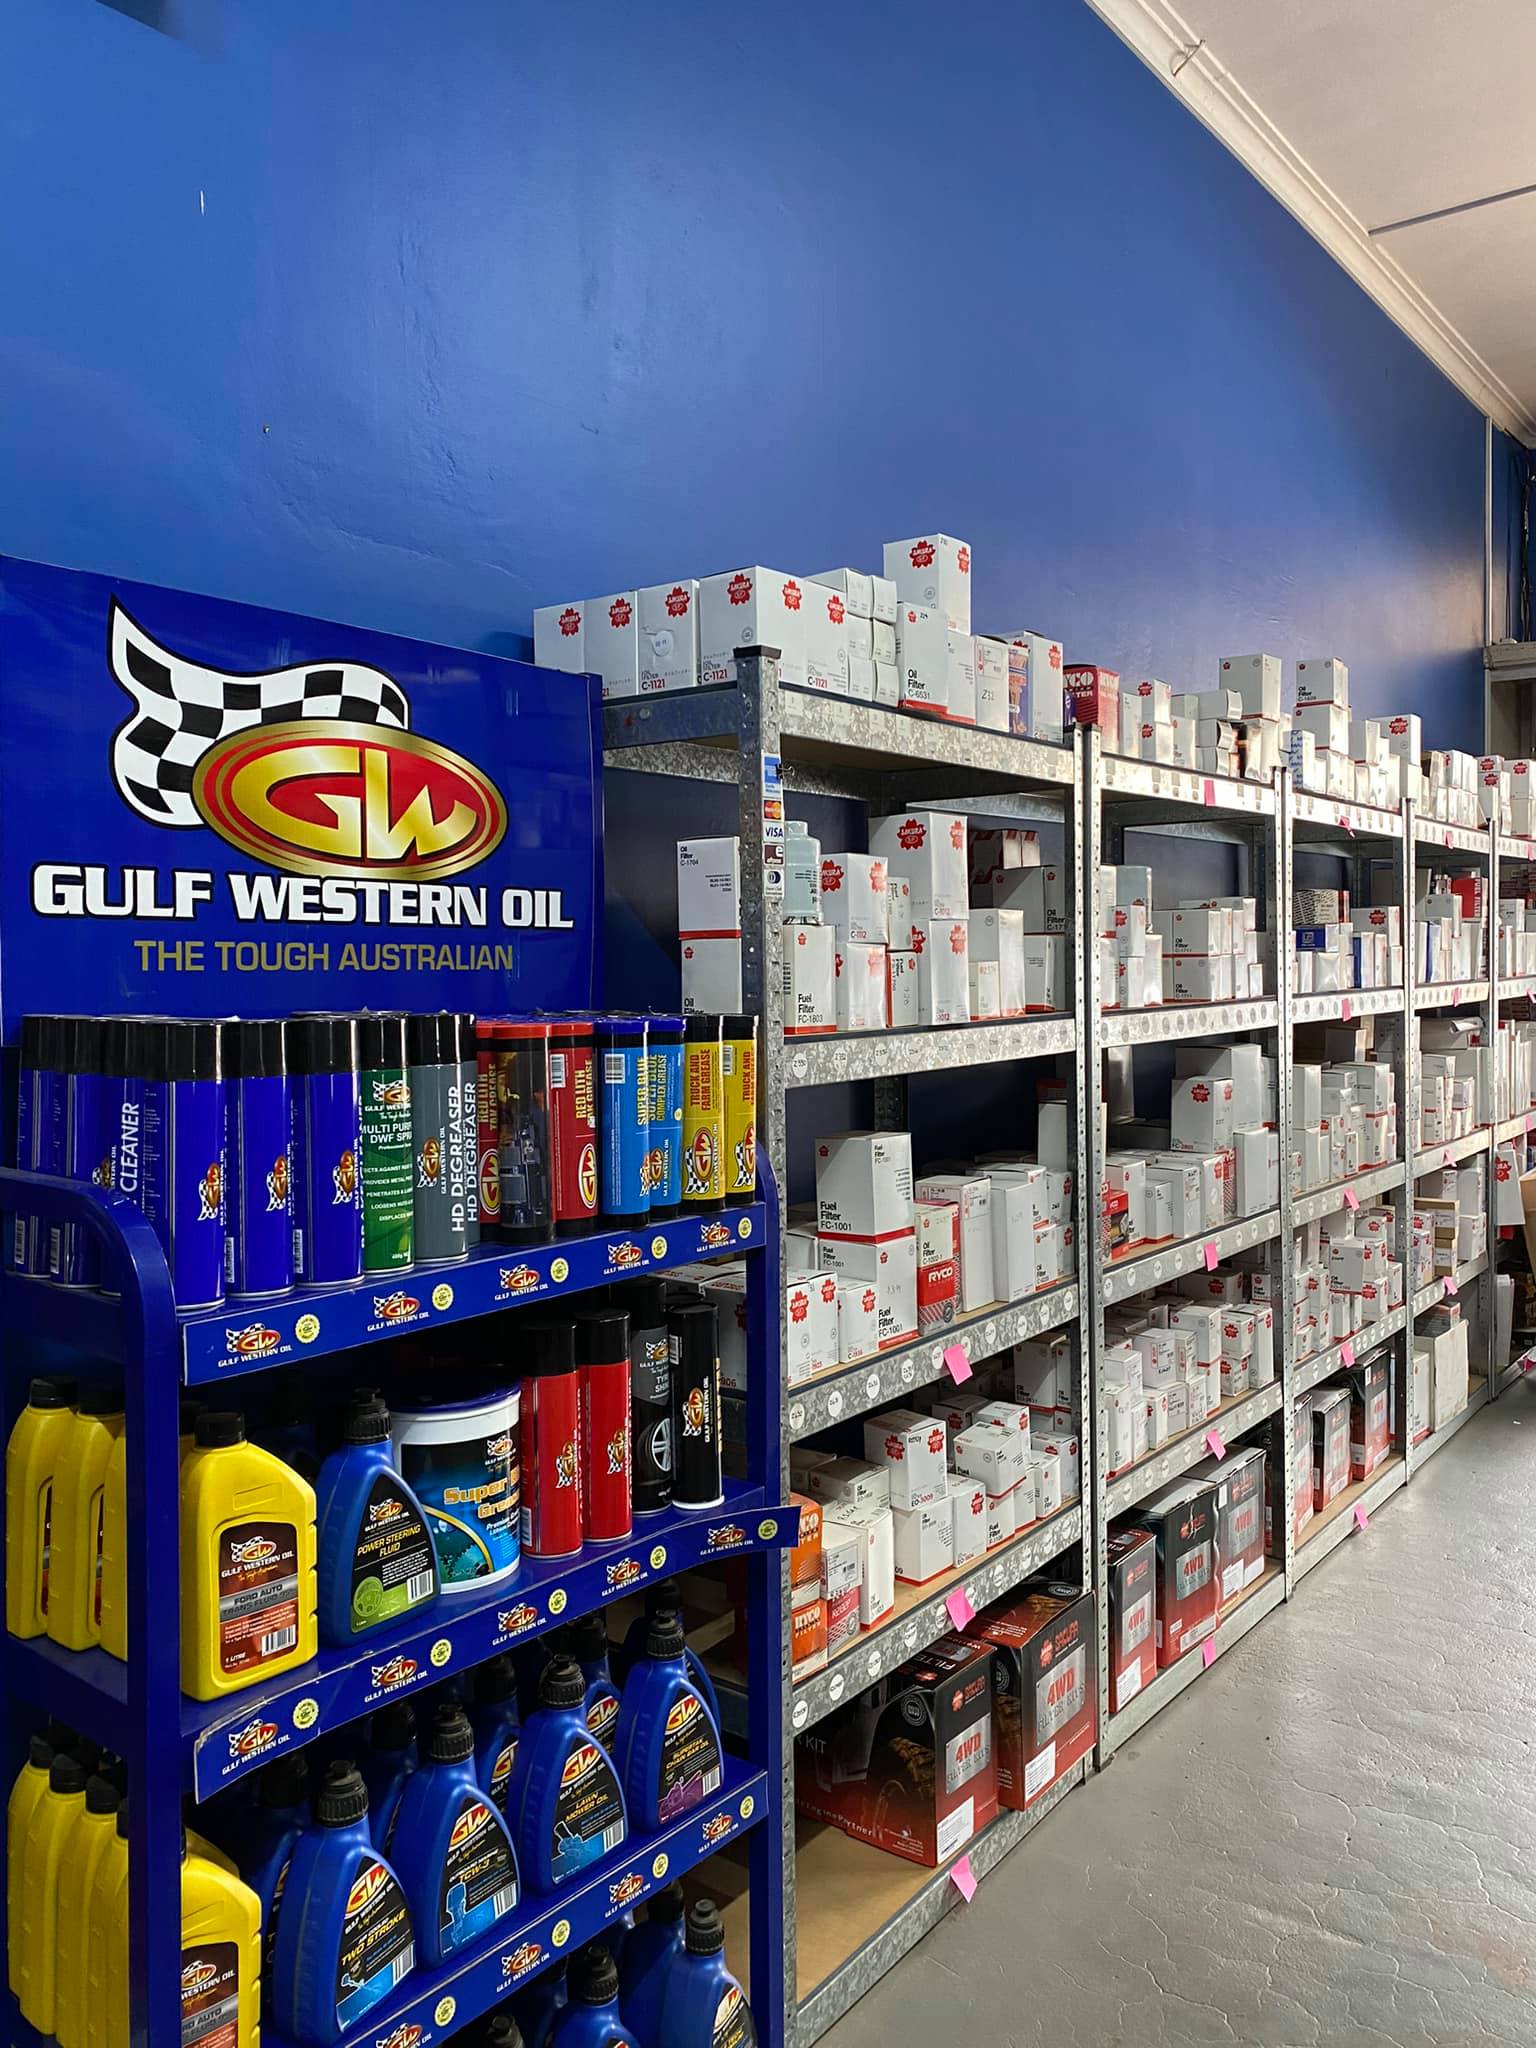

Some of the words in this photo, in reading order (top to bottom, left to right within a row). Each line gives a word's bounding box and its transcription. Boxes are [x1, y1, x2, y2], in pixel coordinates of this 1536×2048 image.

[703, 669, 728, 682] C-1121
[807, 677, 828, 689] C-1121
[908, 668, 918, 679] Oil
[641, 679, 666, 691] C-1121
[908, 679, 926, 690] Filter
[231, 745, 478, 861] GW
[765, 826, 783, 838] VISA
[33, 865, 213, 918] GULF
[228, 873, 488, 926] WESTERN
[501, 889, 575, 929] OIL
[134, 940, 205, 972] THE
[213, 940, 329, 972] TOUGH
[338, 943, 513, 971] AUSTRALIAN
[684, 998, 694, 1008] Oil
[798, 993, 813, 1003] Fuel
[798, 1003, 815, 1014] Filter
[657, 1053, 667, 1087] GREASE
[690, 1054, 700, 1074] AND
[701, 1048, 711, 1083] GREASE
[743, 1051, 751, 1070] AND
[574, 1069, 586, 1094] LITH
[690, 1076, 700, 1107] TRUCK
[743, 1075, 751, 1102] TRUCK
[575, 1096, 587, 1119] RED
[701, 1084, 711, 1111] FARM
[448, 1086, 464, 1197] DEGREASER
[465, 1082, 478, 1189] DEGREASER
[120, 1102, 139, 1192] CLEANER
[467, 1195, 478, 1222] HD
[820, 1201, 837, 1211] Fuel
[820, 1211, 841, 1222] Filter
[451, 1203, 465, 1232] HD
[820, 1221, 852, 1231] FC-1001
[823, 1246, 834, 1254] Fuel
[923, 1242, 931, 1250] Oil
[923, 1248, 936, 1257] Filter
[823, 1253, 836, 1261] Filter
[823, 1259, 845, 1268] FC-1001
[510, 1270, 537, 1288] GW
[928, 1267, 953, 1283] RYCO
[494, 1292, 510, 1301] GULF
[510, 1286, 539, 1299] WESTERN
[538, 1283, 549, 1291] OIL
[386, 1299, 417, 1316] GW
[878, 1308, 891, 1319] Fuel
[367, 1320, 387, 1332] GULF
[387, 1314, 418, 1327] WESTERN
[419, 1311, 430, 1320] OIL
[878, 1317, 894, 1328] Filter
[241, 1331, 277, 1351] GW
[218, 1356, 239, 1367] GULF
[240, 1349, 278, 1363] WESTERN
[280, 1344, 292, 1353] OIL
[444, 1478, 508, 1505] Super
[244, 1543, 274, 1560] GW
[357, 1539, 385, 1557] POWER
[385, 1525, 421, 1546] STEERING
[379, 1543, 401, 1558] FLUID
[221, 1566, 242, 1578] GULF
[242, 1555, 280, 1570] WESTERN
[281, 1550, 295, 1560] OIL
[1183, 1552, 1204, 1577] 4WD
[234, 1592, 259, 1605] FORD
[260, 1584, 283, 1597] AUTO
[508, 1606, 536, 1627] GW
[1127, 1605, 1146, 1633] 4WD
[492, 1634, 508, 1646] GULF
[508, 1622, 537, 1639] WESTERN
[536, 1617, 547, 1627] OIL
[382, 1660, 415, 1682] GW
[364, 1690, 382, 1703] GULF
[383, 1675, 417, 1693] WESTERN
[417, 1670, 428, 1680] OIL
[1047, 1667, 1075, 1706] 4WD
[587, 1699, 619, 1731] GW
[665, 1696, 700, 1732] GW
[239, 1723, 275, 1748] GW
[805, 1734, 827, 1754] KIT
[222, 1760, 241, 1775] GULF
[241, 1742, 277, 1763] WESTERN
[278, 1734, 290, 1745] OIL
[955, 1731, 981, 1764] 4WD
[563, 1747, 599, 1784] GW
[576, 1791, 599, 1809] LAWN
[565, 1801, 596, 1822] MOWER
[451, 1807, 489, 1848] GW
[457, 1859, 490, 1882] TCW-3
[347, 1865, 388, 1914] GW
[342, 1941, 365, 1966] TWO
[366, 1907, 407, 1947] STROKE
[518, 1945, 542, 1966] GW
[222, 1970, 236, 1981] OIL
[497, 1979, 513, 1993] GULF
[513, 1958, 540, 1985] WESTERN
[539, 1951, 550, 1963] OIL
[197, 2007, 222, 2023] AUTO
